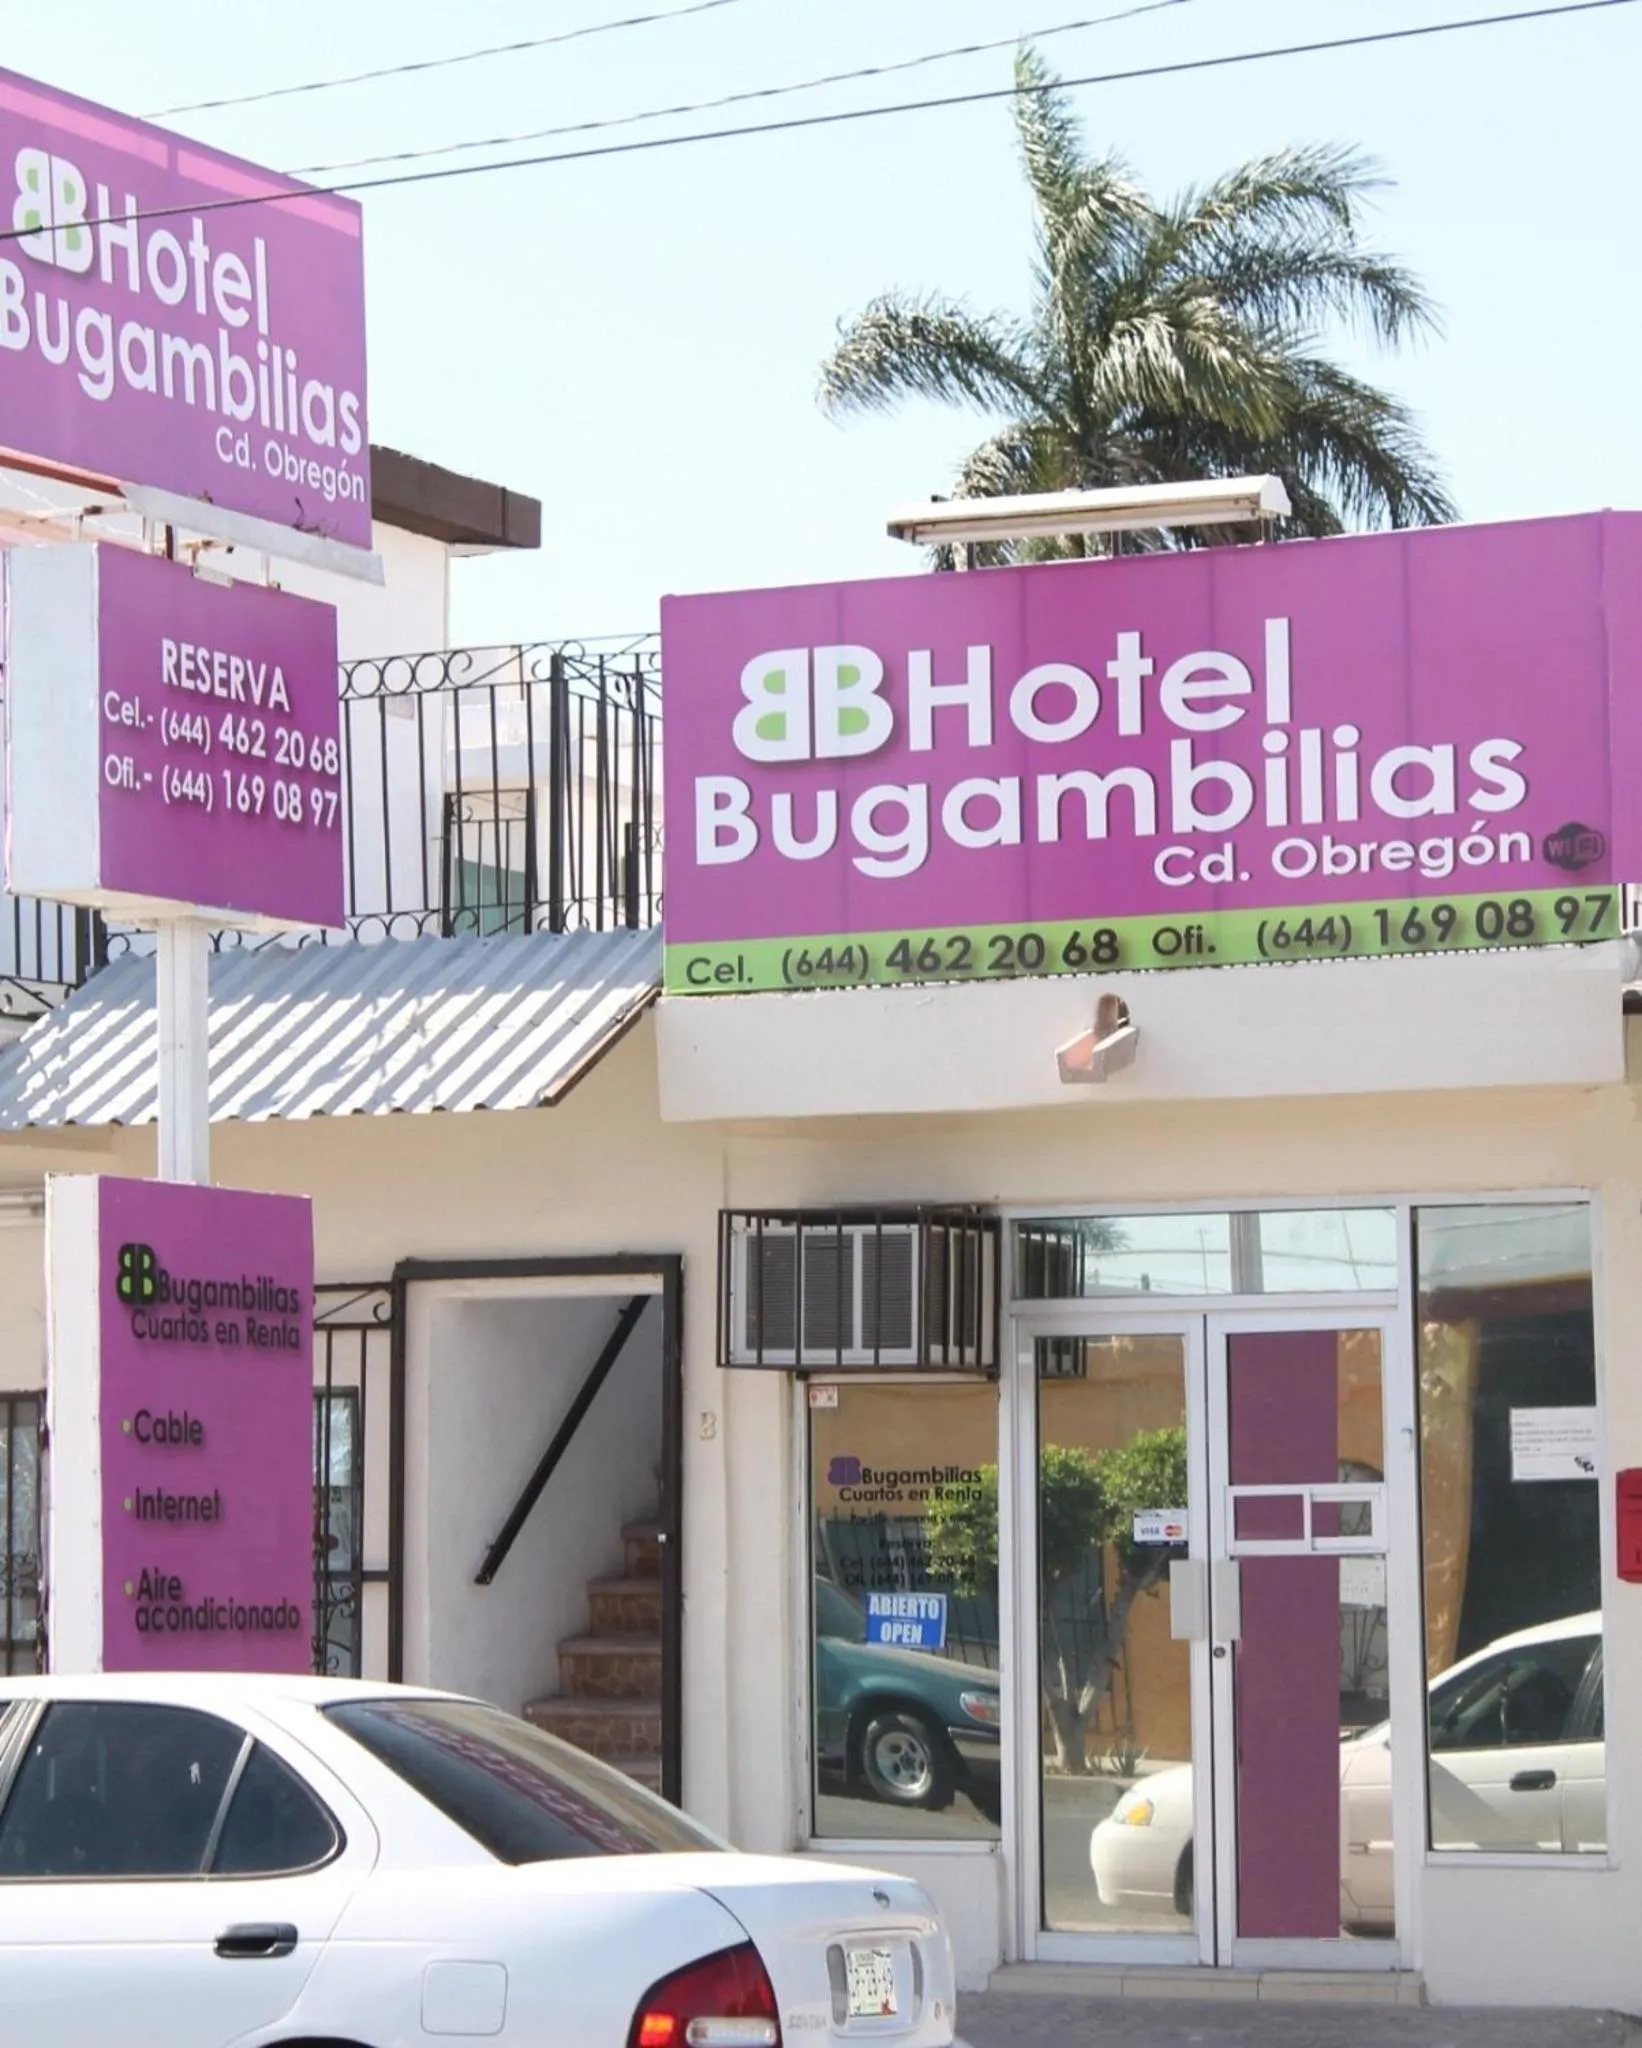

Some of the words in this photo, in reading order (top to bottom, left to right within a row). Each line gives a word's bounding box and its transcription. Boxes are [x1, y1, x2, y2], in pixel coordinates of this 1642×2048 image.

[97, 183, 269, 334] Hotel
[0, 258, 362, 454] Bugambilias
[215, 426, 257, 471] Cd.
[264, 440, 366, 503] Obregón
[161, 637, 290, 712] RESERVA
[908, 617, 1292, 752] Hotel
[161, 707, 211, 755] (644)
[218, 712, 267, 758] 462
[274, 727, 305, 768] 20
[309, 735, 339, 775] 68
[162, 764, 213, 812] (644)
[222, 769, 266, 815] 169
[273, 780, 302, 822] 08
[310, 788, 338, 828] 97
[695, 724, 1527, 878] Bugambilias
[1154, 842, 1251, 887] Cd.
[1271, 820, 1532, 878] Obregón
[686, 955, 754, 985] Cel.
[782, 944, 869, 984] (644)
[885, 935, 973, 974] 462
[987, 932, 1045, 970] 20
[1062, 928, 1120, 967] 68
[1152, 925, 1217, 956] Ofi.
[1257, 914, 1352, 957] (644)
[1373, 903, 1457, 946] 169
[1475, 899, 1535, 940] 08
[1554, 894, 1612, 934] 97
[157, 1269, 299, 1314] Bugambilias
[131, 1309, 209, 1344] Cuartos
[215, 1321, 240, 1345] en
[246, 1317, 300, 1349] Renta
[134, 1408, 204, 1446] Cable
[135, 1486, 221, 1521] Internet
[839, 1486, 904, 1502] Cuartos
[908, 1489, 930, 1502] en
[861, 1466, 982, 1489] Bugambilias
[137, 1566, 183, 1601] Aire
[868, 1594, 940, 1620] ABIERTO
[135, 1597, 301, 1633] acondicionado
[880, 1620, 923, 1645] OPEN
